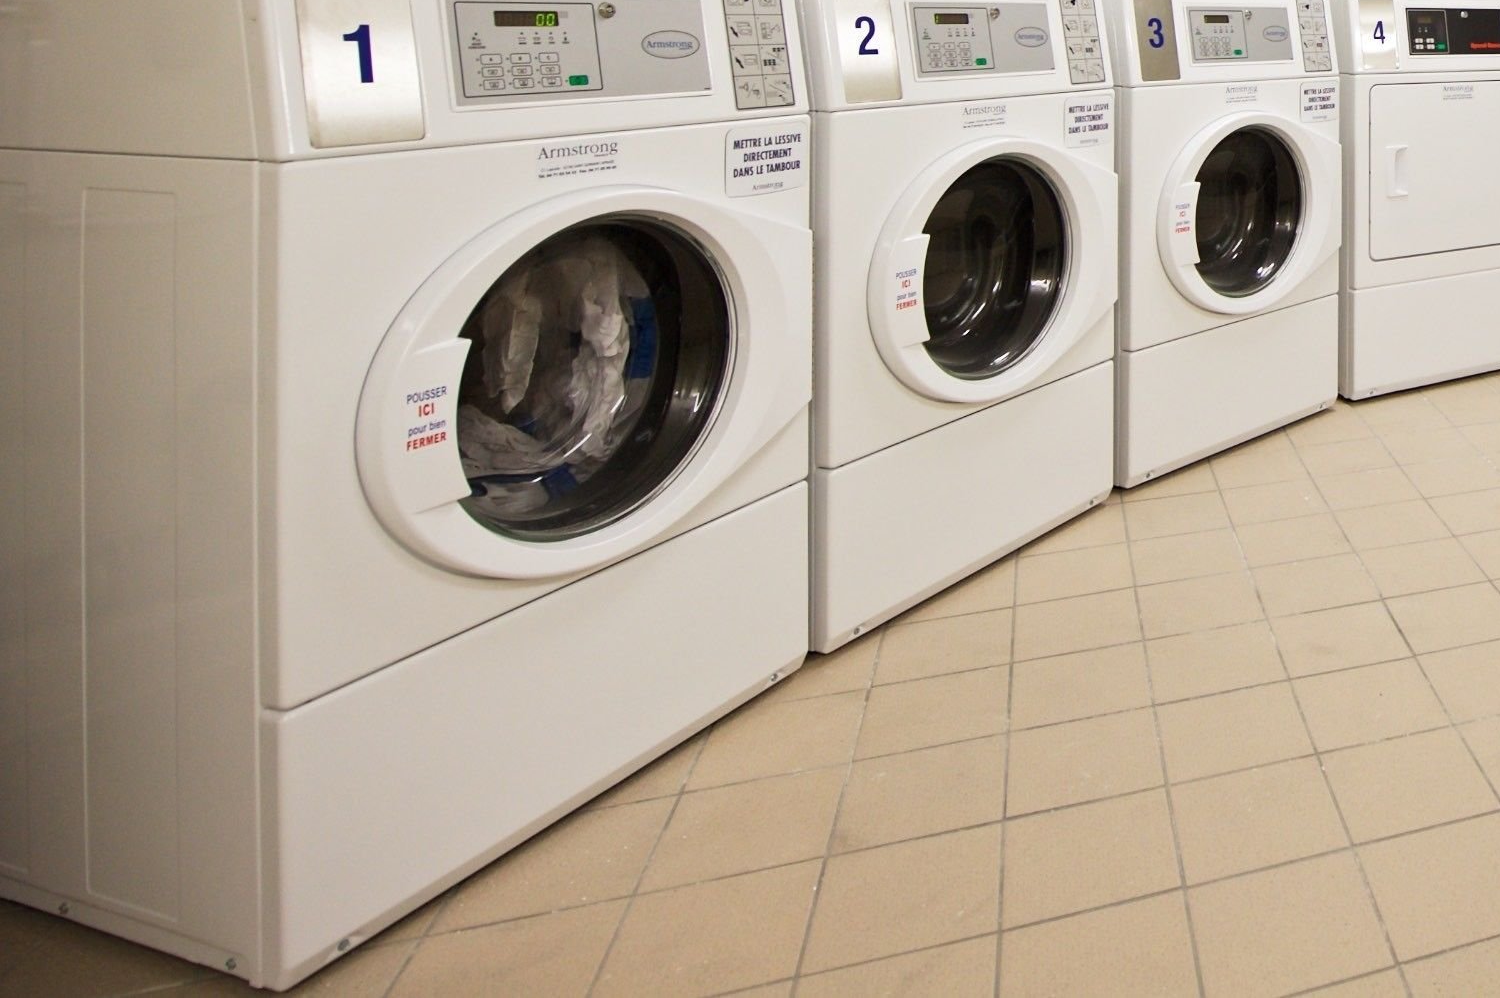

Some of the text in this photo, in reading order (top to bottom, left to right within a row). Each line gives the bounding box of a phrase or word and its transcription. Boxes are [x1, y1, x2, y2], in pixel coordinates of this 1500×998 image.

[855, 16, 878, 55] 2
[1148, 18, 1164, 48] 3
[1374, 21, 1386, 44] 4
[647, 41, 692, 49] Armstrong
[343, 24, 374, 83] 1
[962, 105, 1007, 116] Armstrong
[1068, 105, 1085, 114] METTRE
[1075, 114, 1104, 124] DIRECTEMENT
[1068, 126, 1081, 134] DANS
[1088, 123, 1108, 132] TAMBOUR
[733, 134, 801, 150] METTRE LA LESSIVE
[538, 142, 618, 160] Armstrong
[744, 148, 792, 162] DIRECTEMENT
[733, 160, 800, 178] DANS LE TAMBOUR
[896, 269, 916, 279] POUSSER
[902, 279, 911, 288] ICI
[896, 299, 916, 310] FERMER
[407, 386, 447, 404] POUSSER
[419, 402, 434, 417] ICI
[408, 420, 445, 438] pour bien
[406, 432, 446, 451] FERMER
